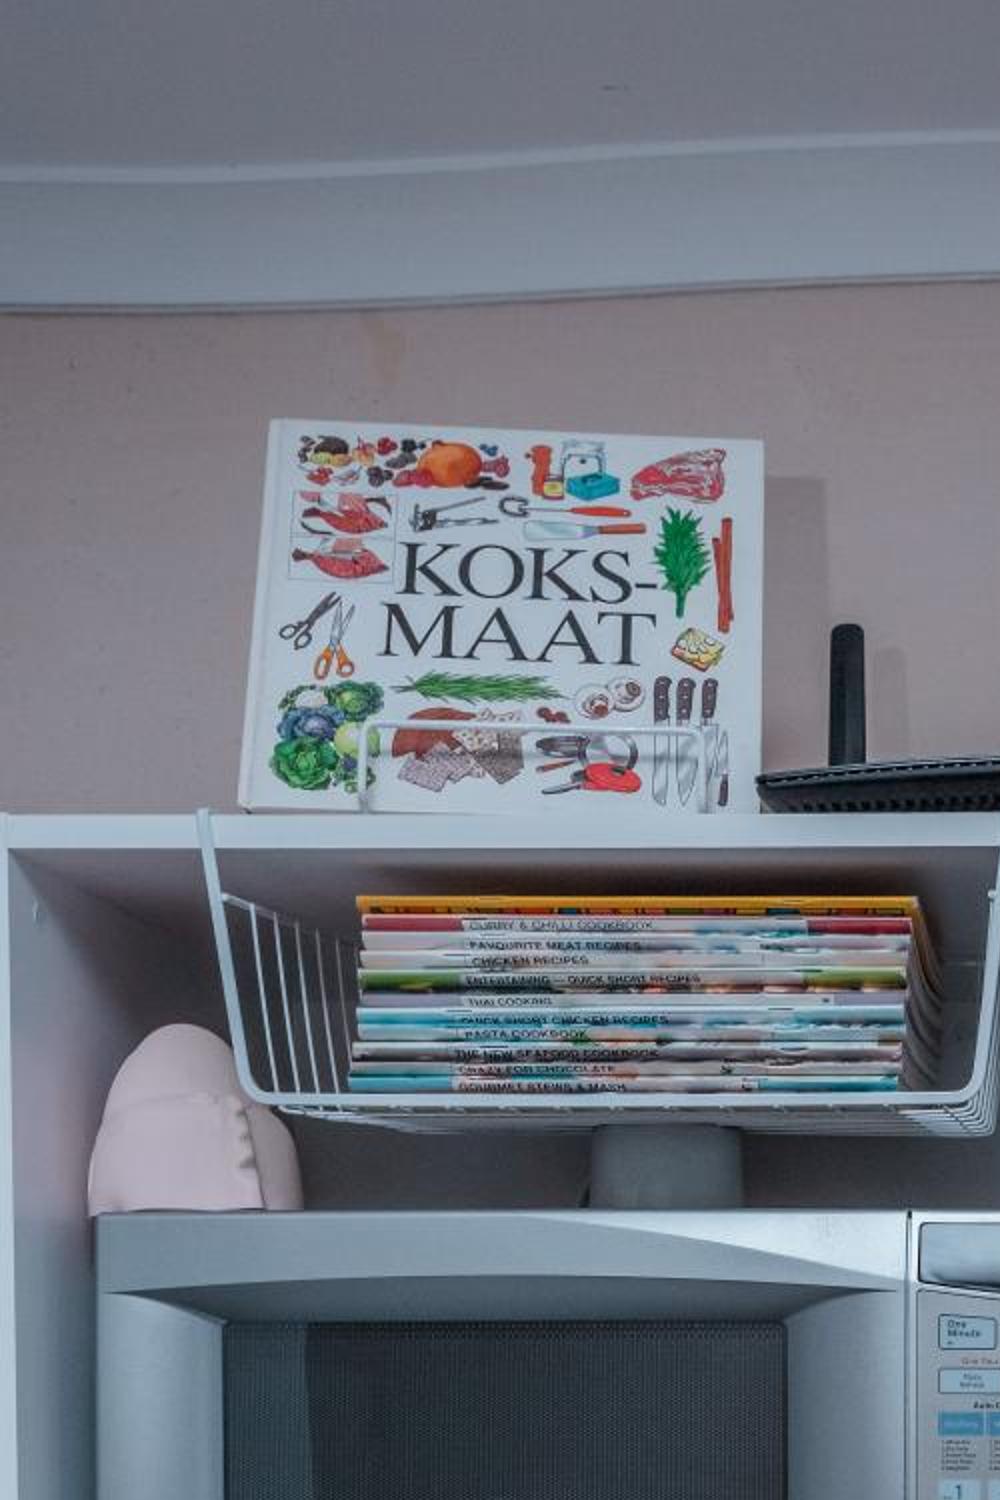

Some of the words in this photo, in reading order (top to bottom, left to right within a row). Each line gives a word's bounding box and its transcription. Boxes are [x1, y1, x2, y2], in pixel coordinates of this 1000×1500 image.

[395, 541, 658, 604] KOKS-
[377, 602, 657, 666] MAAT
[546, 941, 583, 951] MEAT
[472, 956, 530, 966] CHICKEN
[533, 956, 590, 966] RECIPES
[567, 975, 603, 985] QUICK
[607, 975, 648, 985] SHORT
[650, 975, 702, 984] RECIPES
[552, 1015, 609, 1025] CHICKEN
[613, 1015, 670, 1025] RECIPES
[464, 1029, 509, 1039] PASTA
[517, 1049, 579, 1059] SEAFOOD
[536, 1064, 616, 1074] CHOCOLATE
[458, 1082, 523, 1093] GOURMET
[955, 1484, 962, 1500] 1
